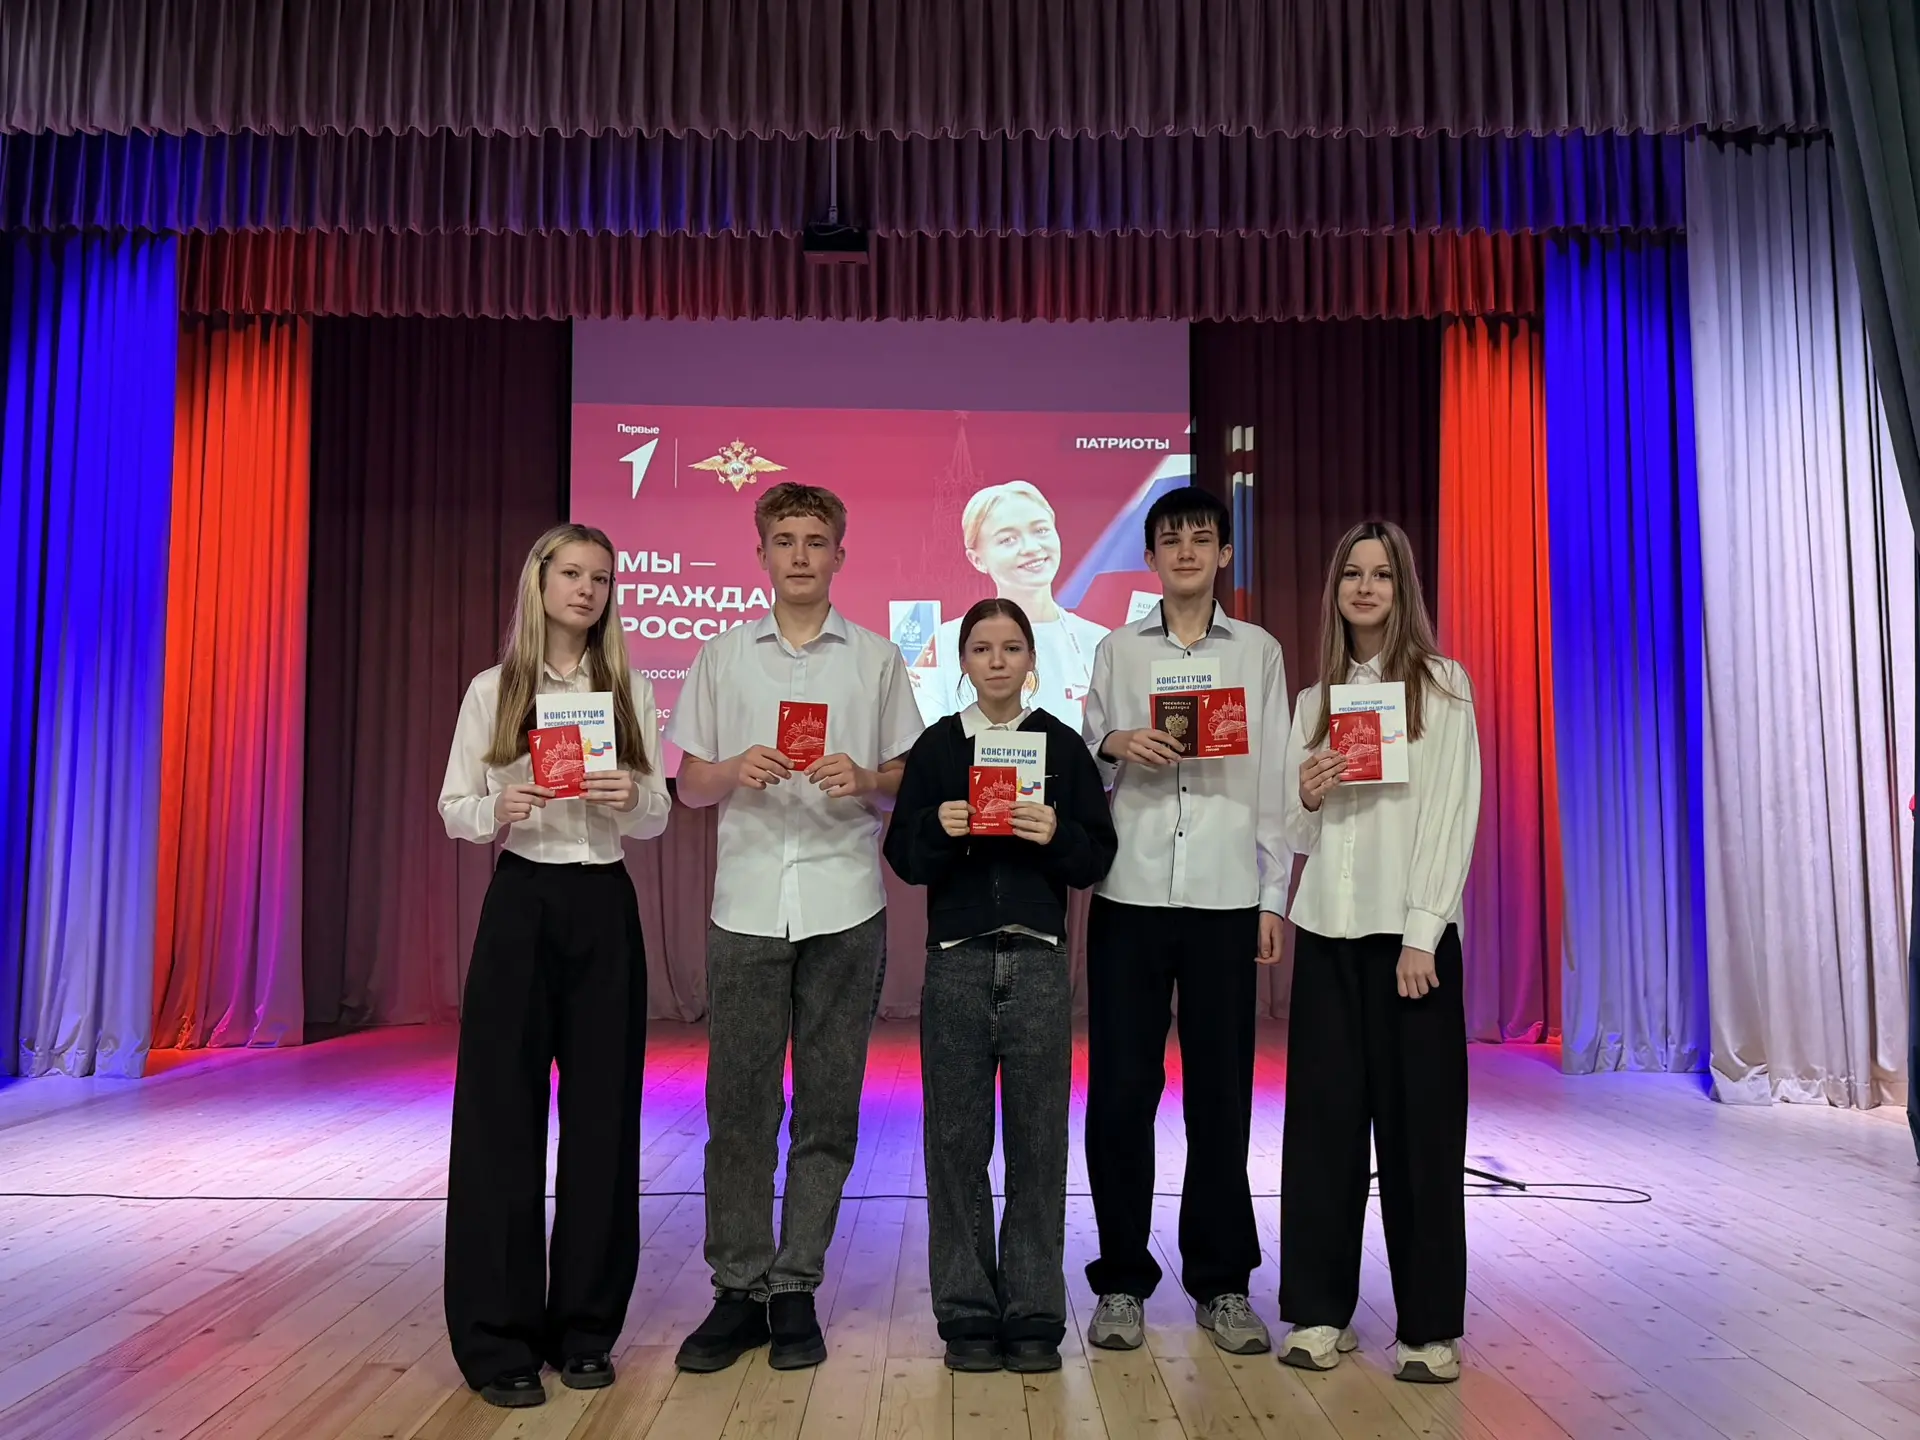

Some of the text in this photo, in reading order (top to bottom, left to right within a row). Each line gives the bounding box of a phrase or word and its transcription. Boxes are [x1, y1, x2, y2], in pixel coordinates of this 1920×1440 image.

[617, 423, 660, 436] Первые
[1076, 437, 1170, 450] ПАТРИОТЫ
[617, 551, 681, 574] МЫ
[616, 583, 776, 613] ГРАЖДА
[1156, 674, 1212, 685] КОНСТИТУЦИЯ
[544, 710, 605, 720] КОНСТИТУЦИЯ
[981, 747, 1038, 758] КОНСТИТУЦИЯ
